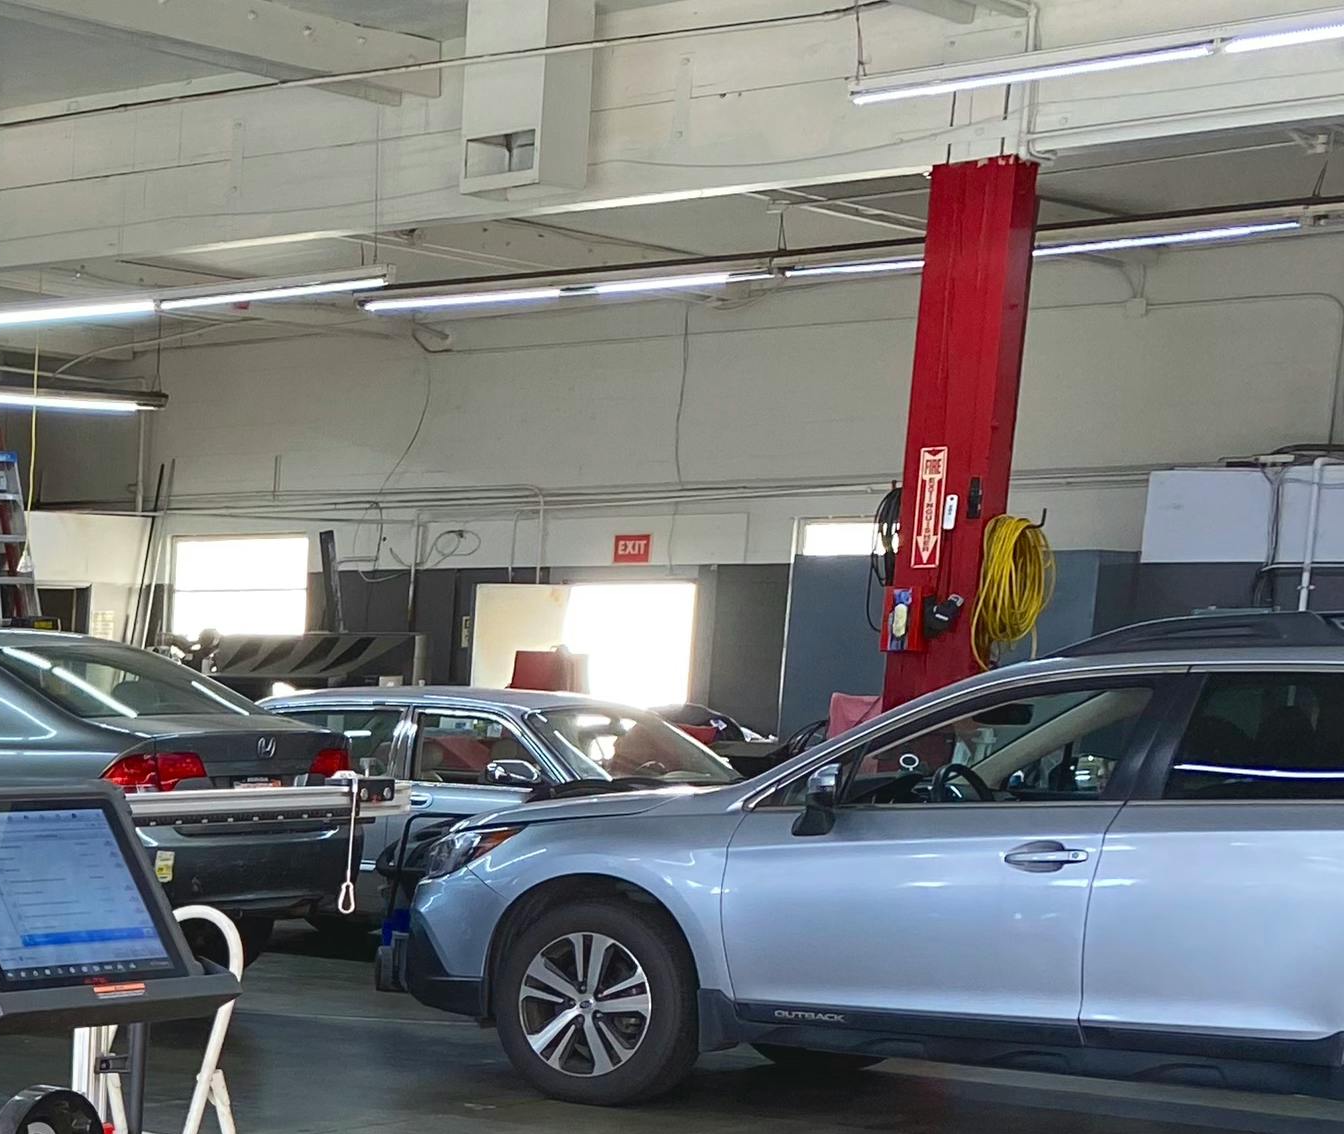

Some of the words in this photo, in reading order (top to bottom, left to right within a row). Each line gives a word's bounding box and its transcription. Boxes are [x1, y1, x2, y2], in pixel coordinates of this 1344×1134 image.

[924, 458, 943, 475] FIRE
[617, 540, 648, 555] EXIT
[774, 1010, 847, 1023] OUTBACK
